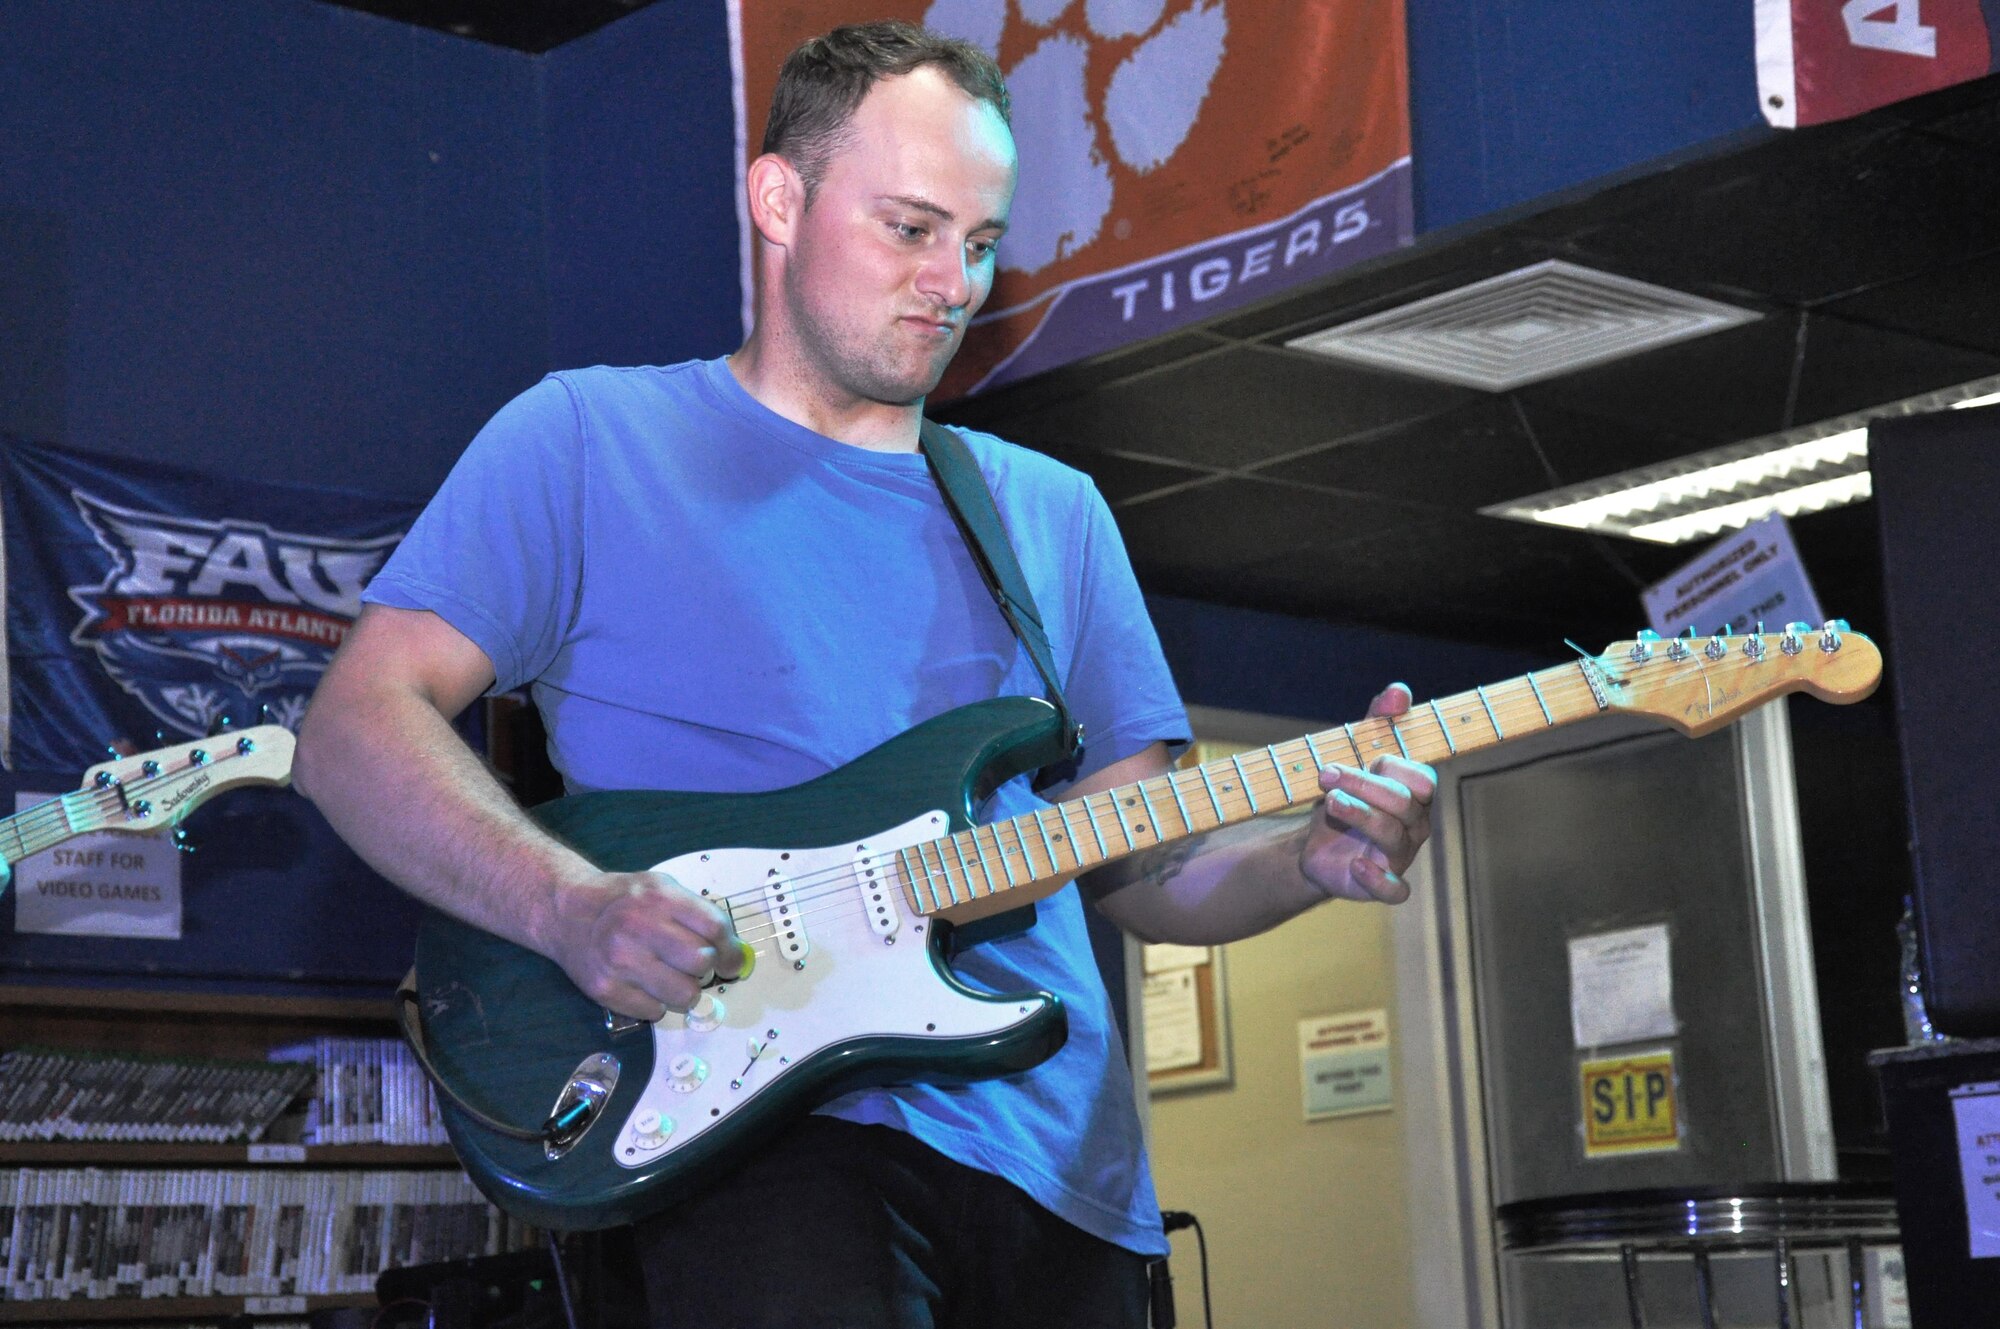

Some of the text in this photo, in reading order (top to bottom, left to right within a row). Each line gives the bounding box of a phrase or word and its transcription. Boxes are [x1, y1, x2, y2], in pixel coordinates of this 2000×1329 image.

[1111, 198, 1370, 321] TIGERS
[100, 513, 387, 616] FAU
[1663, 568, 1742, 624] PERSONNEL
[1742, 542, 1779, 574] ONLY
[1675, 537, 1758, 598] AUTHORIZED
[126, 604, 353, 643] FLORIDA ATLANTI
[37, 879, 162, 902] VIDEO GAMES
[52, 849, 145, 871] STAFF FOR
